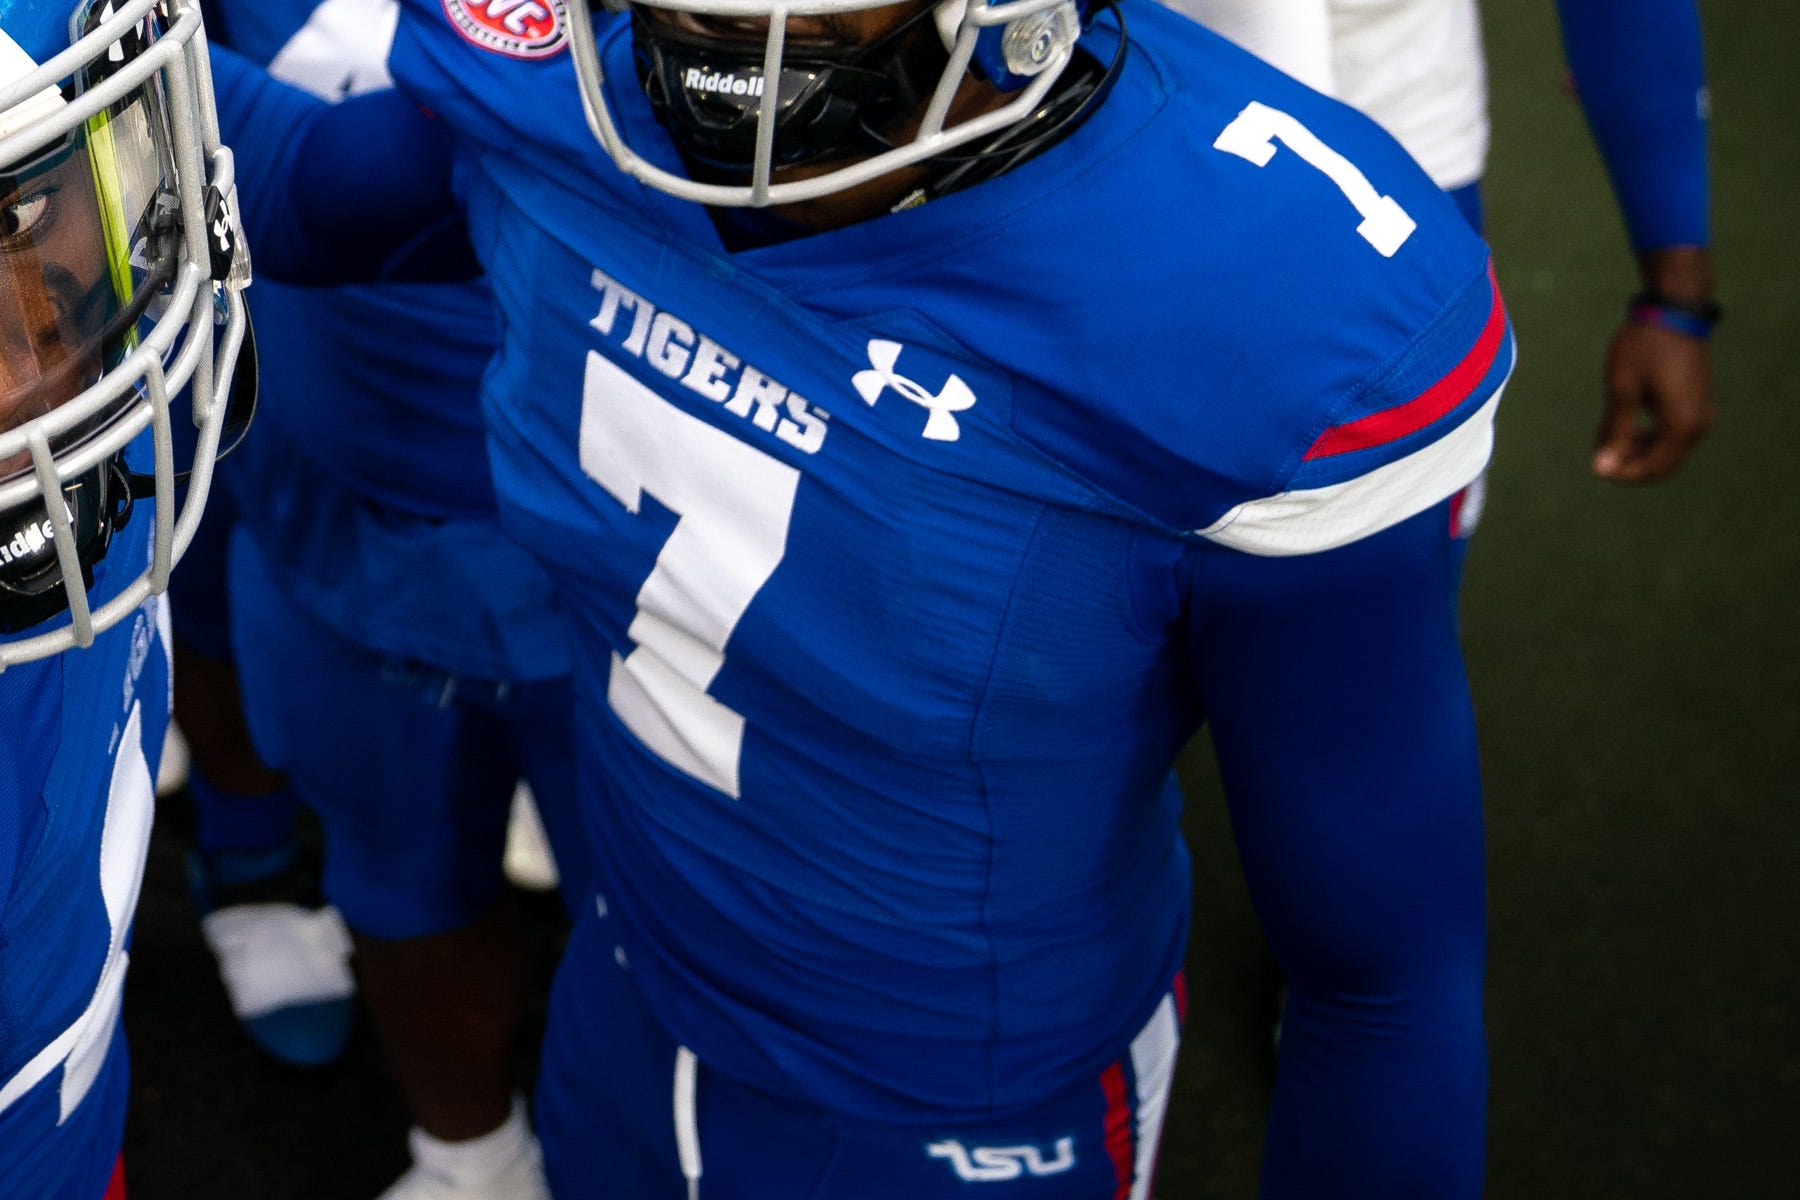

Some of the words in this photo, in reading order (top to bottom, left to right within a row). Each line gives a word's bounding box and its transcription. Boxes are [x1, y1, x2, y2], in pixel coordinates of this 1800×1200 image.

[1212, 100, 1417, 257] 7
[588, 267, 831, 455] TIGERS
[578, 348, 801, 800] 7
